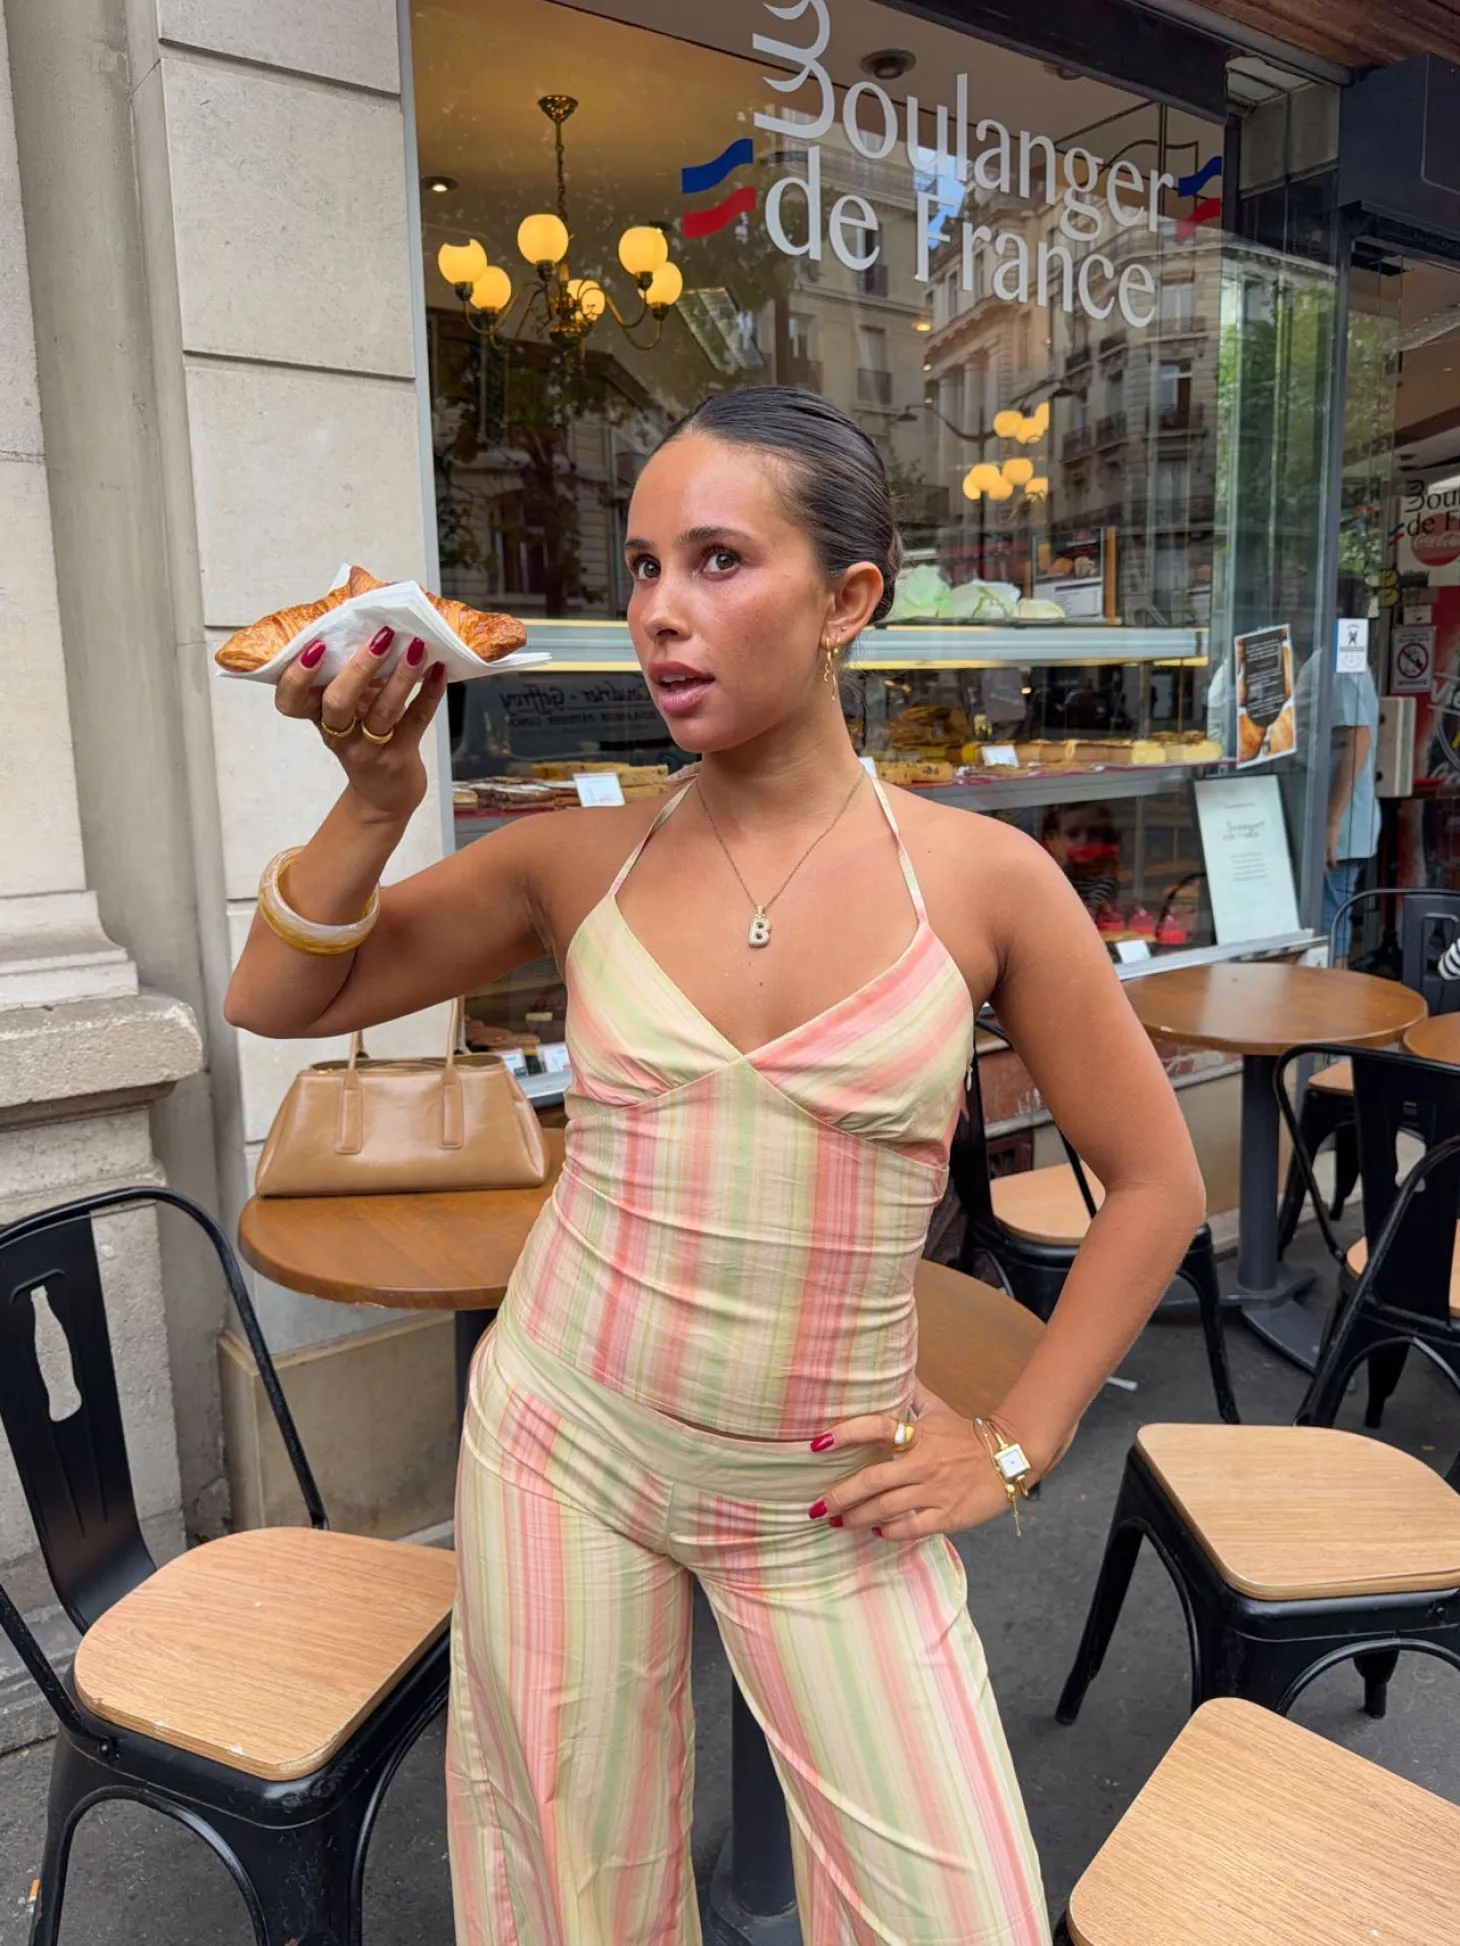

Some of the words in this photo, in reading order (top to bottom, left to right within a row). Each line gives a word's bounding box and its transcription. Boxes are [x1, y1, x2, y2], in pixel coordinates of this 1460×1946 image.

[752, 0, 1175, 242] Boulanger
[764, 146, 881, 271] de
[915, 190, 1157, 328] France
[1407, 512, 1436, 537] de
[748, 917, 771, 948] B
